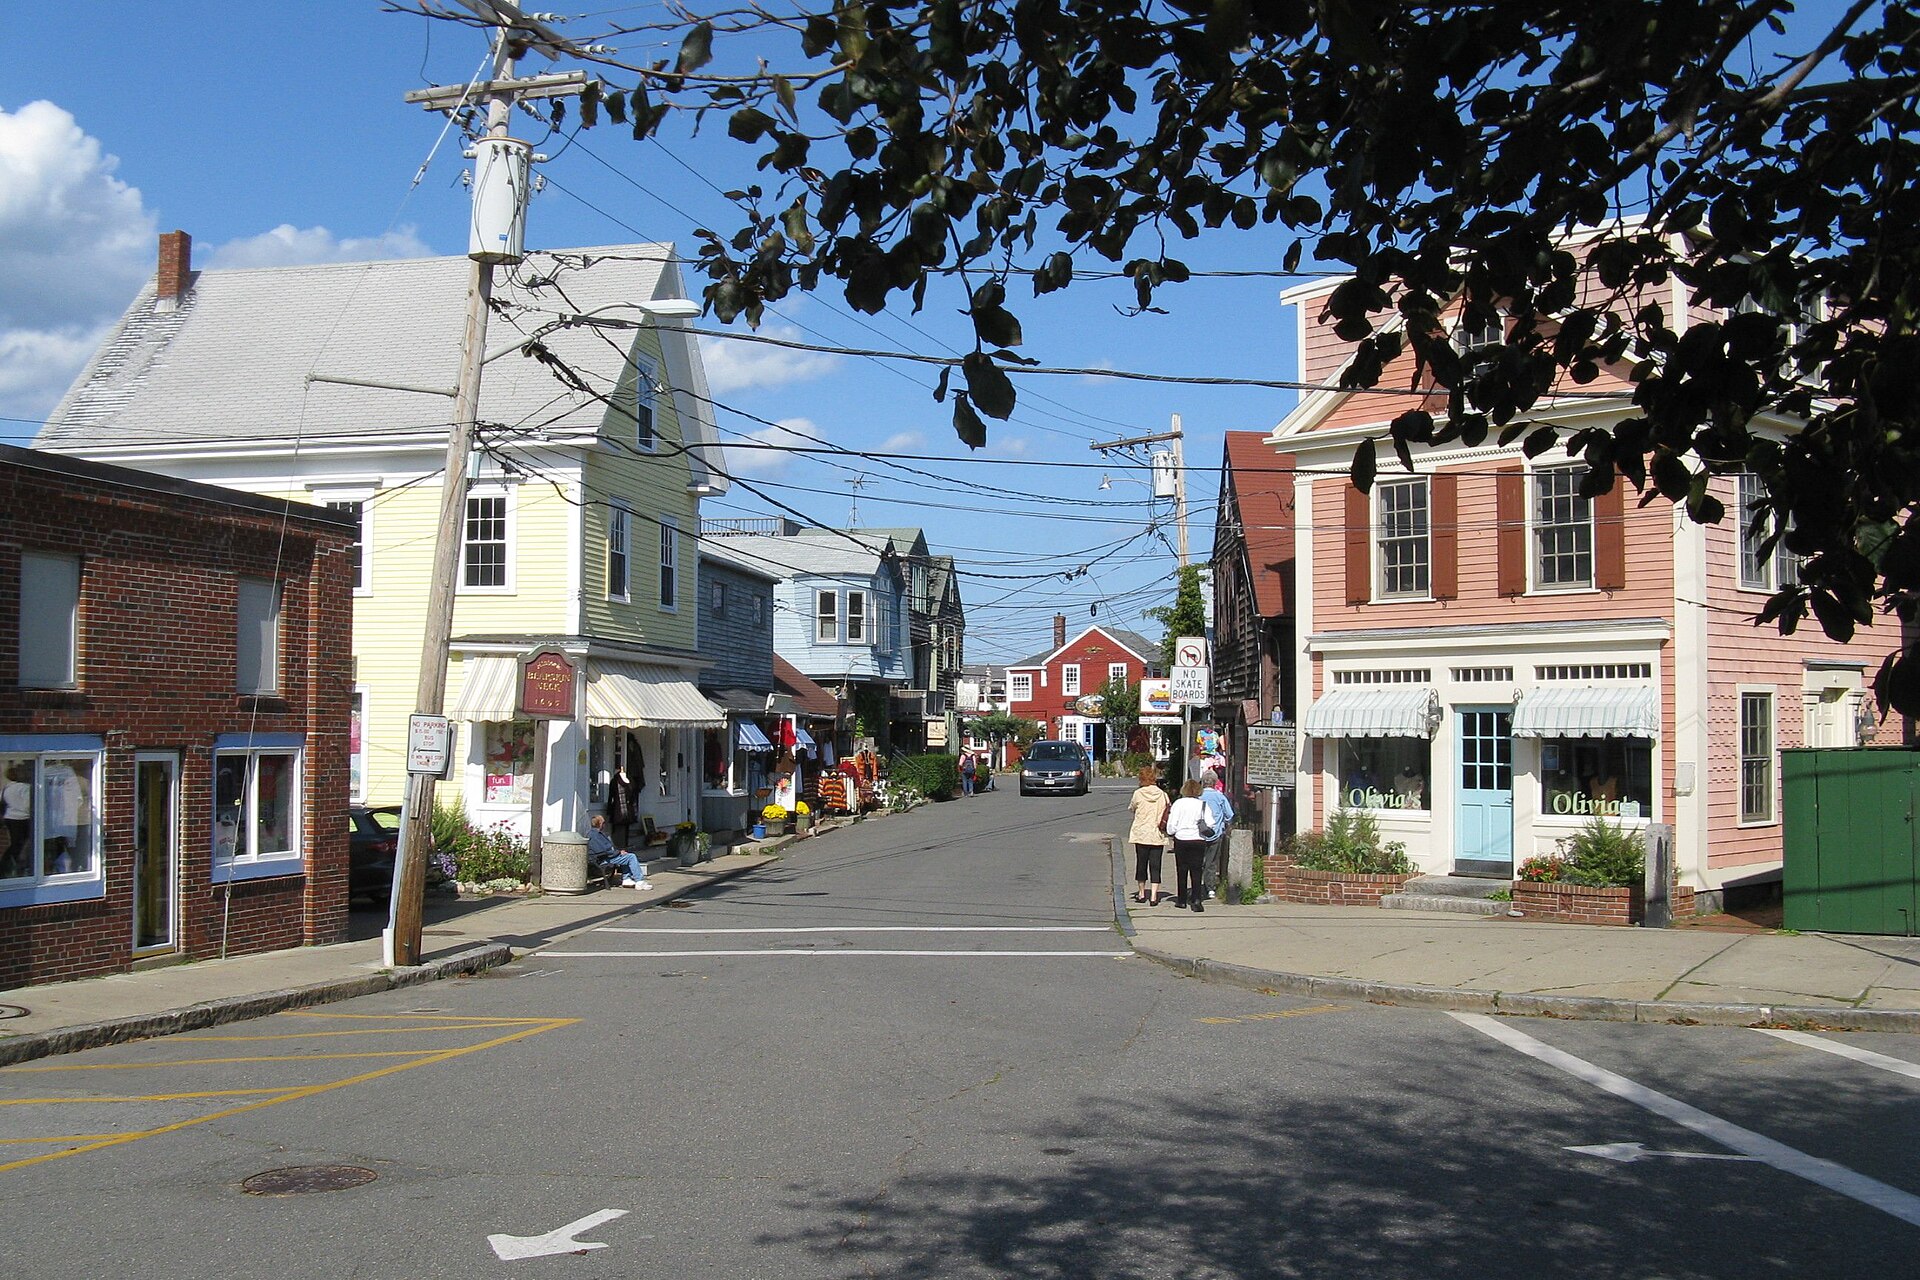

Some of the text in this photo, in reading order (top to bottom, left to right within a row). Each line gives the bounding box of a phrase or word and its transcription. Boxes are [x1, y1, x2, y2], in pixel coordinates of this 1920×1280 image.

[1183, 669, 1196, 679] NO
[1176, 680, 1202, 689] SKATE
[1173, 690, 1205, 699] BOARDS
[1349, 785, 1422, 810] Olivia's
[1553, 791, 1639, 815] Olivia's
